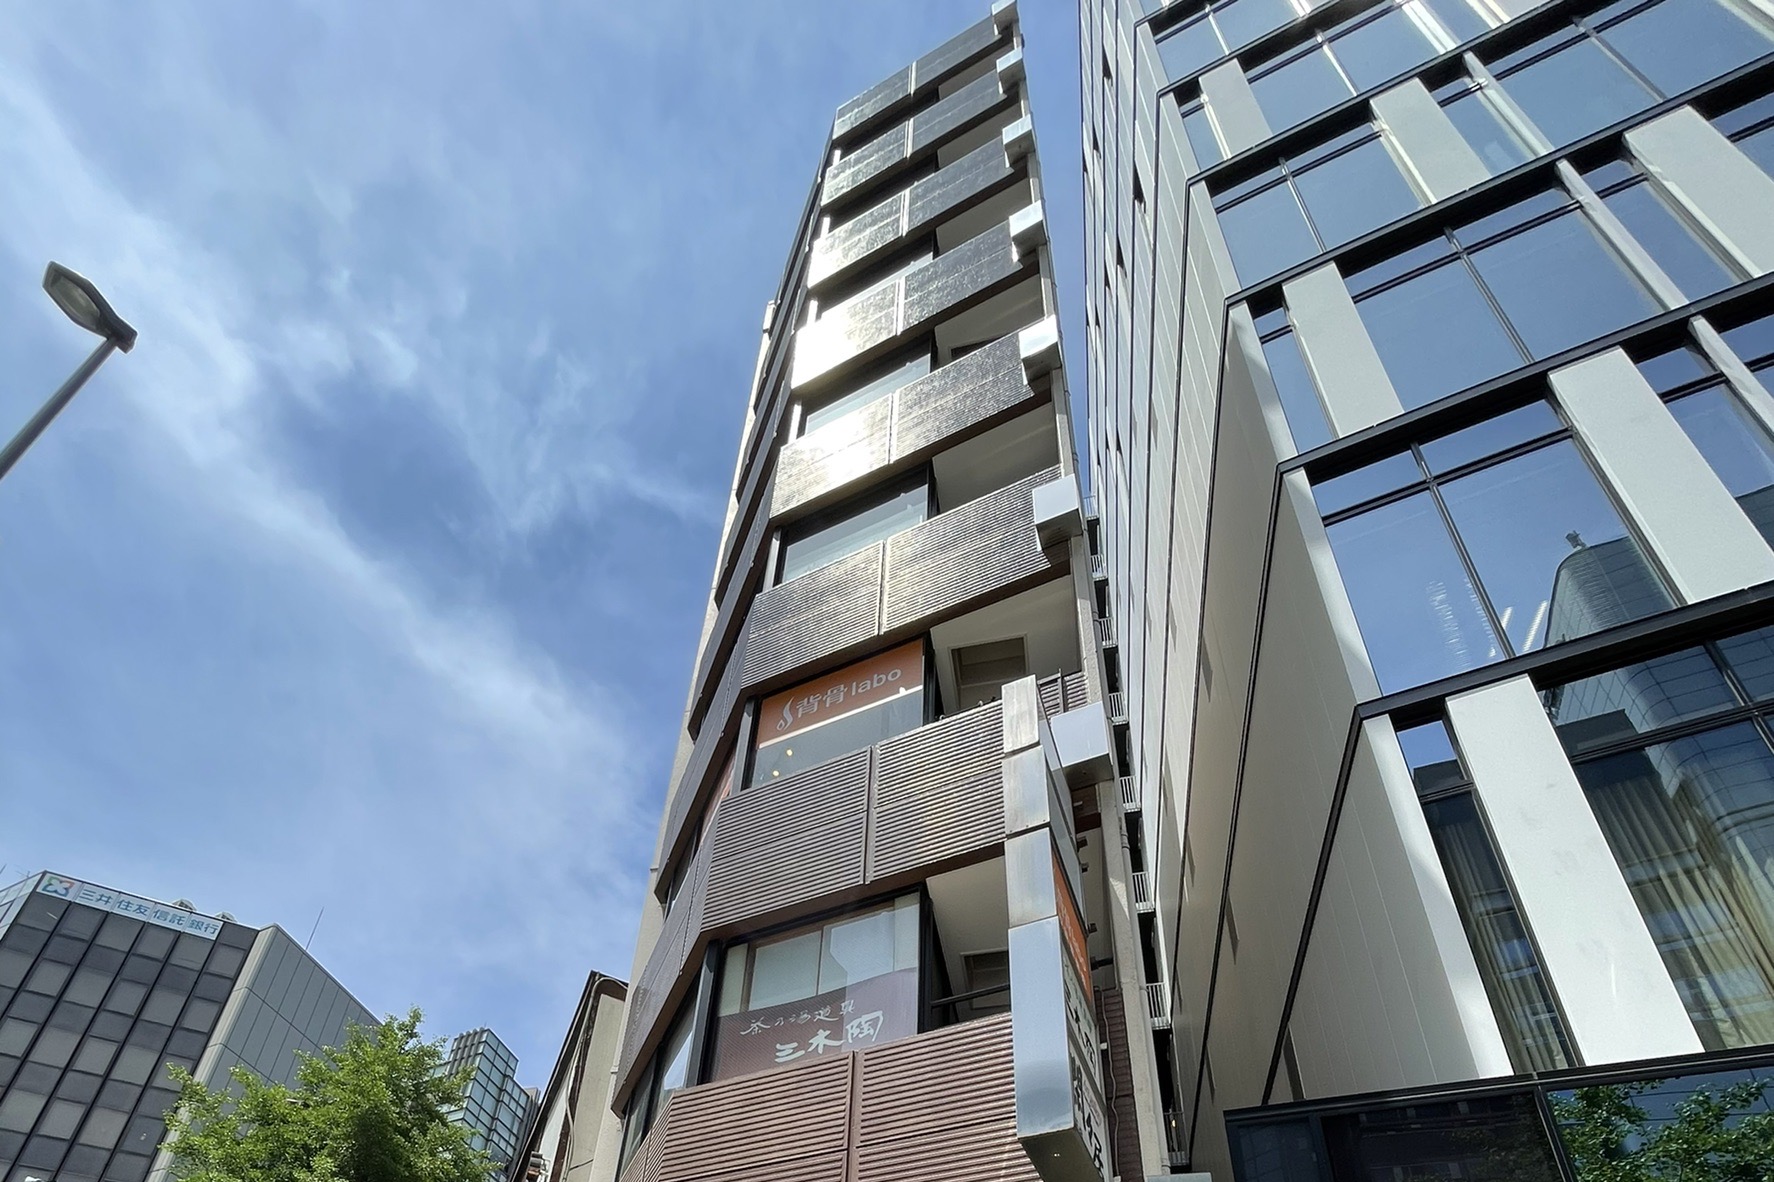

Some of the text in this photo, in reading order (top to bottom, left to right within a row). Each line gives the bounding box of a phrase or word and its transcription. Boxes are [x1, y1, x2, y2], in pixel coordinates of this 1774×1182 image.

[797, 668, 902, 717] 背骨labo
[79, 888, 219, 935] 三井住友信託銀行
